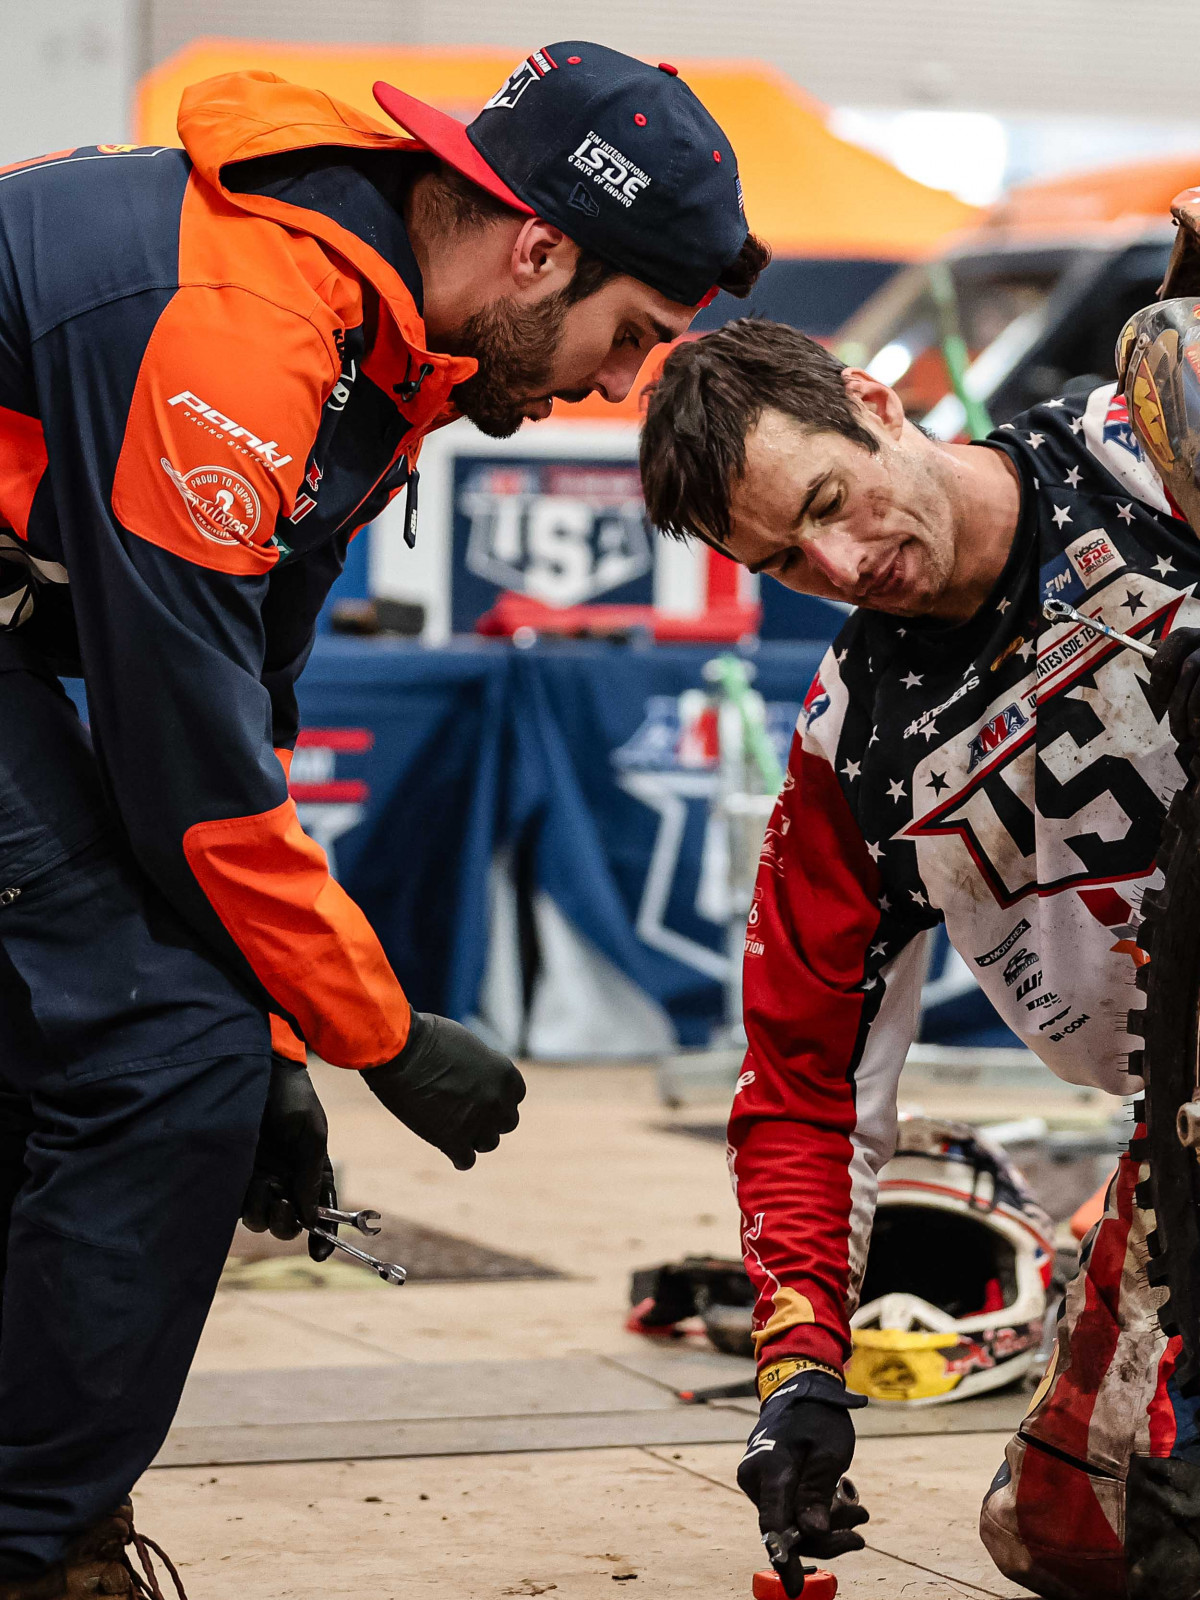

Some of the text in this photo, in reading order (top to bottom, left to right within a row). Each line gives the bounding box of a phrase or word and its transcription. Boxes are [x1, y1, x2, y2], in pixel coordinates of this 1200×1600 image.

[573, 138, 647, 200] ISDE
[586, 130, 652, 186] FIM INTERNATIONAL
[568, 155, 633, 208] 6 DAYS OF ENDURO
[184, 411, 276, 473] RACING SYSTEMS
[191, 473, 254, 519] PROUD TO SUPPORT
[1045, 567, 1073, 593] FIM
[1077, 543, 1112, 571] ISDE
[1060, 633, 1084, 659] ISDE
[967, 702, 1029, 774] AMA
[744, 939, 765, 956] TION
[990, 923, 1026, 961] MOTOREX
